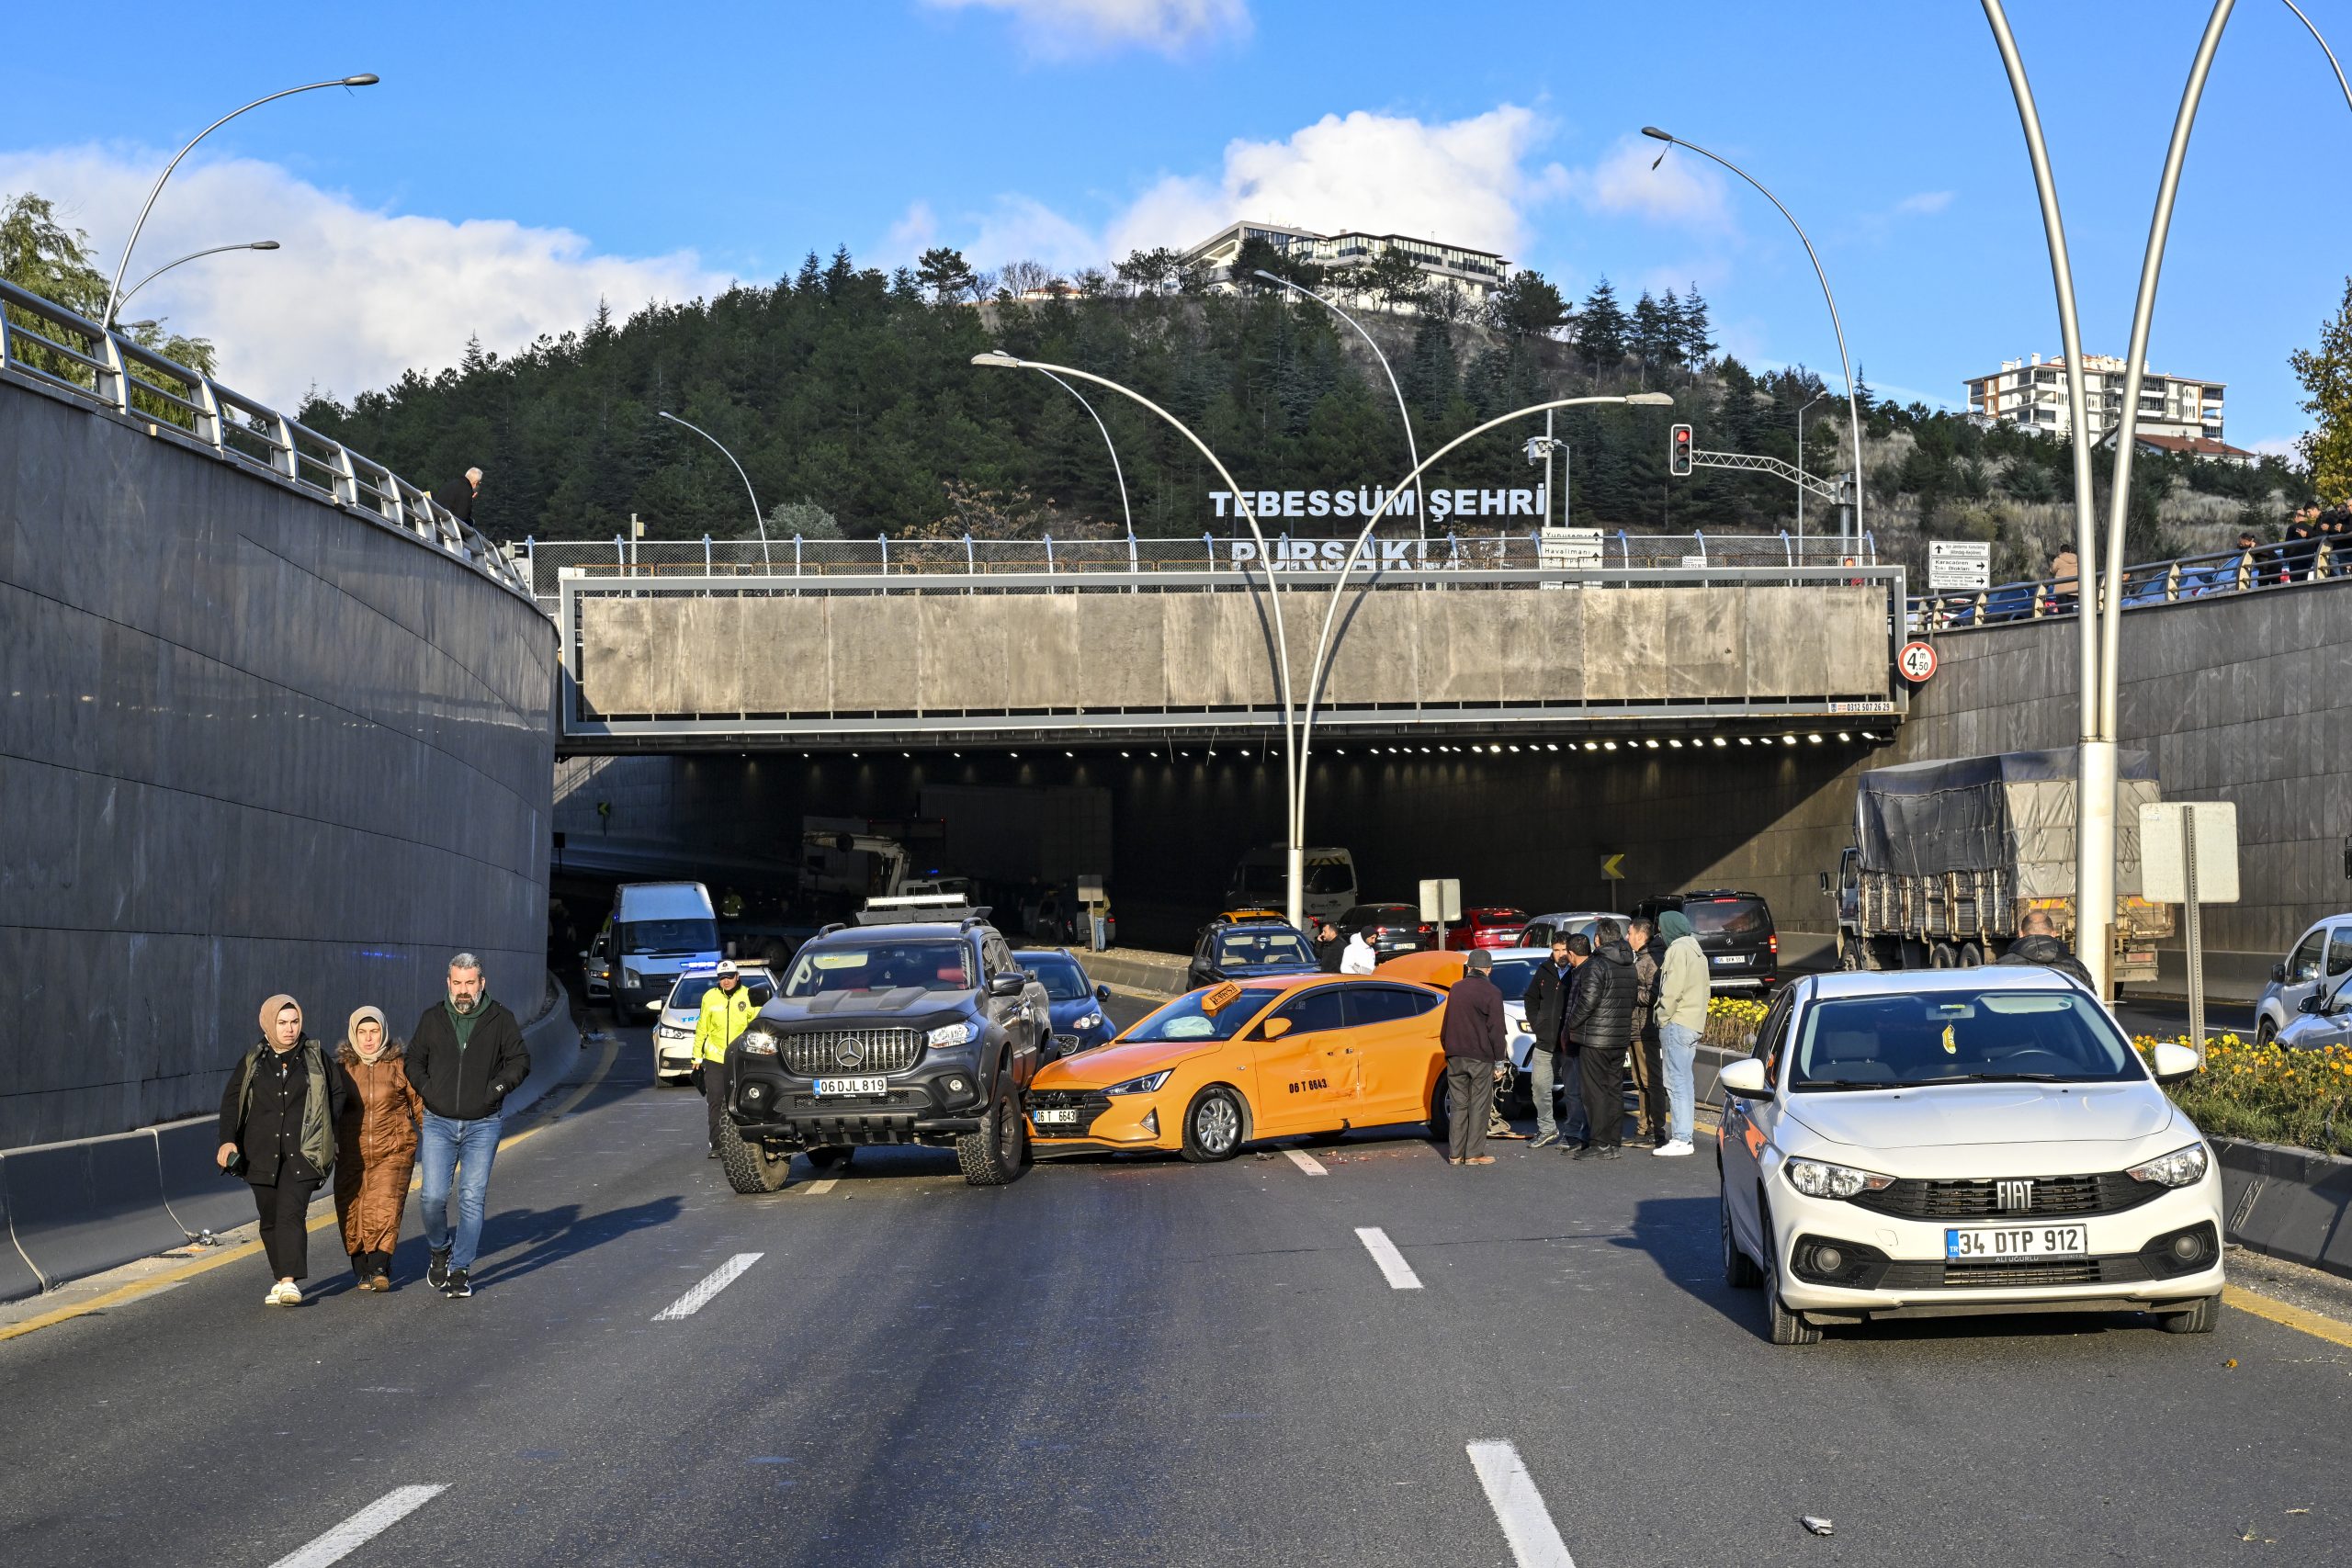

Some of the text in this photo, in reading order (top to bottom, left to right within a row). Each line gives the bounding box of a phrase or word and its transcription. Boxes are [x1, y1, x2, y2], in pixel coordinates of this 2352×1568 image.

[1209, 483, 1545, 523] TEBESSÜM ŞEHRİ
[1232, 541, 1511, 570] PURSAKL
[821, 1081, 835, 1092] 06
[838, 1080, 859, 1091] DJL
[863, 1079, 884, 1091] 819
[1289, 1083, 1300, 1093] 06
[1301, 1081, 1306, 1092] T
[1037, 1111, 1075, 1122] 06 T 6643
[1996, 1181, 2034, 1210] FIAT
[1959, 1229, 2078, 1255] 34 DTP 912
